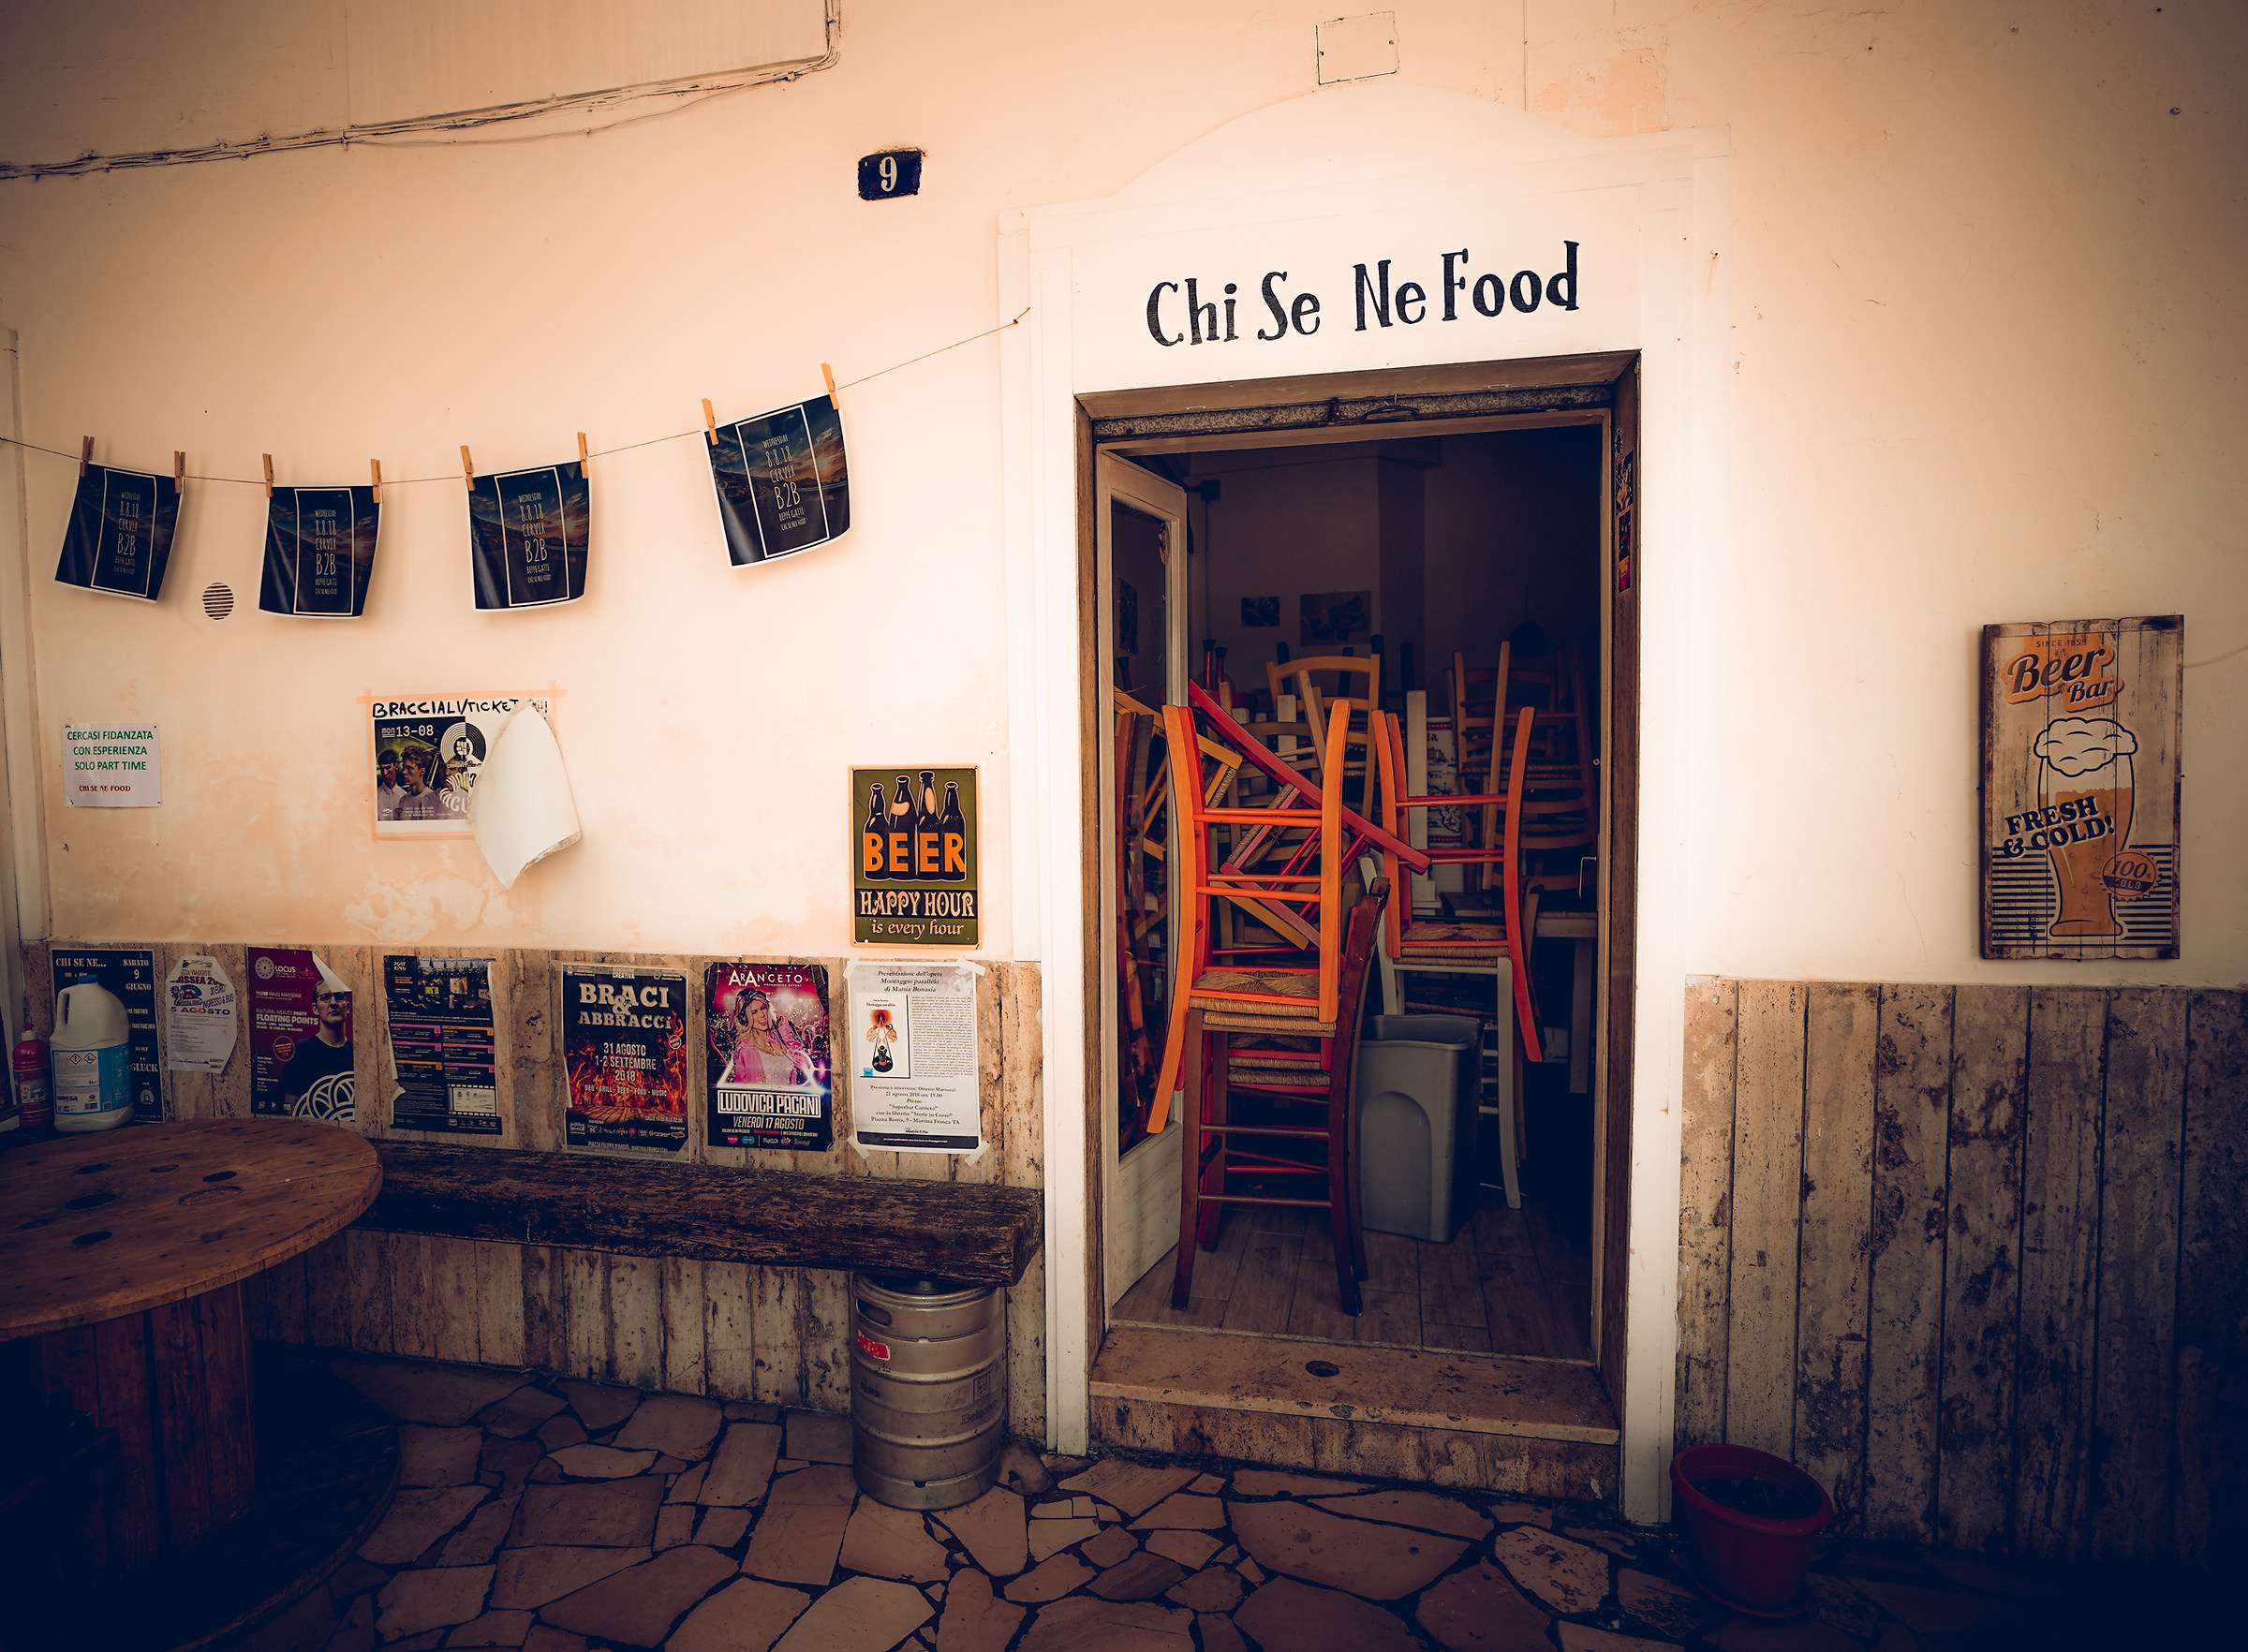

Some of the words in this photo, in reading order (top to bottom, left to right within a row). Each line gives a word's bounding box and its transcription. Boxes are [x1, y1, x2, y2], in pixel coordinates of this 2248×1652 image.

[880, 156, 897, 192] 9
[1146, 277, 1239, 347] Chi
[1257, 271, 1321, 341] Se
[1353, 259, 1426, 332] Ne
[1442, 240, 1579, 321] Food
[762, 434, 789, 450] WEDNESDAY
[765, 445, 792, 468] 8.8.18
[769, 464, 796, 483] CERVIX
[518, 492, 541, 503] WEDNESDAY
[774, 481, 801, 510] B2B
[120, 501, 140, 519] 8.8.18
[519, 503, 544, 522] 8.8.18
[316, 520, 336, 536] 8.8.18
[522, 522, 546, 538] CERVIX
[117, 533, 136, 555] B2B
[316, 538, 337, 550] CERVIX
[525, 538, 548, 563] B2B
[317, 553, 336, 575] B2B
[2036, 640, 2063, 648] SINCE
[2007, 648, 2106, 695] Beer
[2067, 679, 2115, 703] Bar
[67, 730, 100, 741] CERCASI
[103, 730, 154, 740] FIDANZATA
[382, 727, 396, 735] mon
[395, 724, 435, 738] 13-08
[73, 745, 91, 755] CON
[94, 745, 148, 755] ESPERIENZA
[74, 761, 96, 771] SOLO
[97, 761, 120, 770] PART
[122, 761, 147, 770] TIME
[2004, 796, 2099, 835] FRESH
[2003, 837, 2025, 859] &
[2031, 816, 2115, 851] COLD!
[865, 833, 966, 873] BEER
[860, 891, 921, 917] HAPPY
[924, 892, 975, 918] HOUR
[871, 919, 883, 935] is
[887, 922, 924, 940] every
[929, 918, 964, 936] hour
[56, 957, 71, 967] CHI
[74, 958, 84, 967] SE
[134, 968, 140, 980] 9
[579, 982, 670, 1008] BRACI
[612, 995, 632, 1015] &
[256, 1013, 291, 1023] FLOATING
[291, 1017, 319, 1025] POINTS
[603, 1042, 614, 1055] 31
[616, 1043, 646, 1056] AGOSTO
[595, 1055, 608, 1067] 1-2
[610, 1055, 657, 1070] SETTEMBRE
[615, 1069, 636, 1082] 2018
[720, 1092, 775, 1114] LUDOVICA
[776, 1094, 820, 1116] PAGANI
[733, 1114, 764, 1128] VENERDÌ
[765, 1117, 773, 1128] 17
[774, 1118, 805, 1130] AGOSTO
